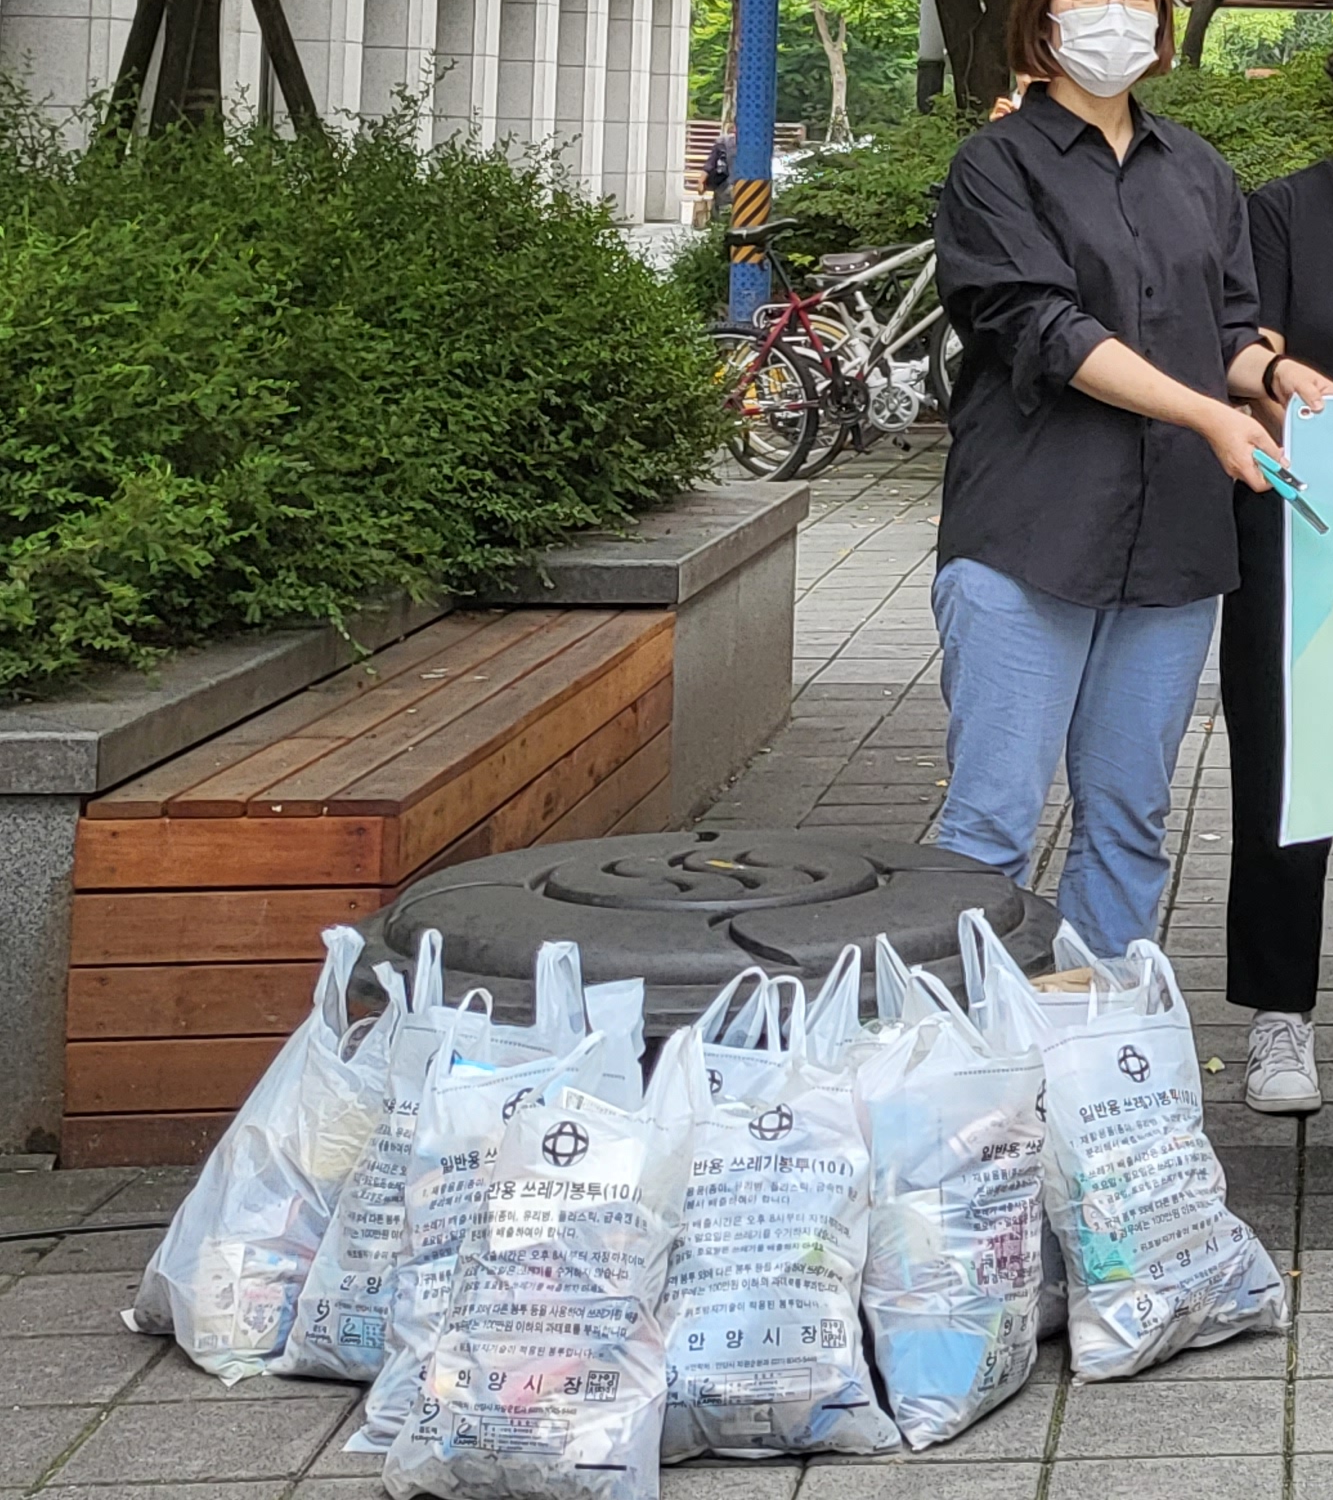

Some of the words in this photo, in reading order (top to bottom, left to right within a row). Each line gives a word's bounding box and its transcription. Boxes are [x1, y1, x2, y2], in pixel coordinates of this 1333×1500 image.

[1079, 1100, 1121, 1124] 일반용
[440, 1150, 480, 1175] 일반용
[693, 1158, 724, 1176] 반용
[487, 1181, 516, 1200] 반용
[530, 1250, 551, 1262] 오후
